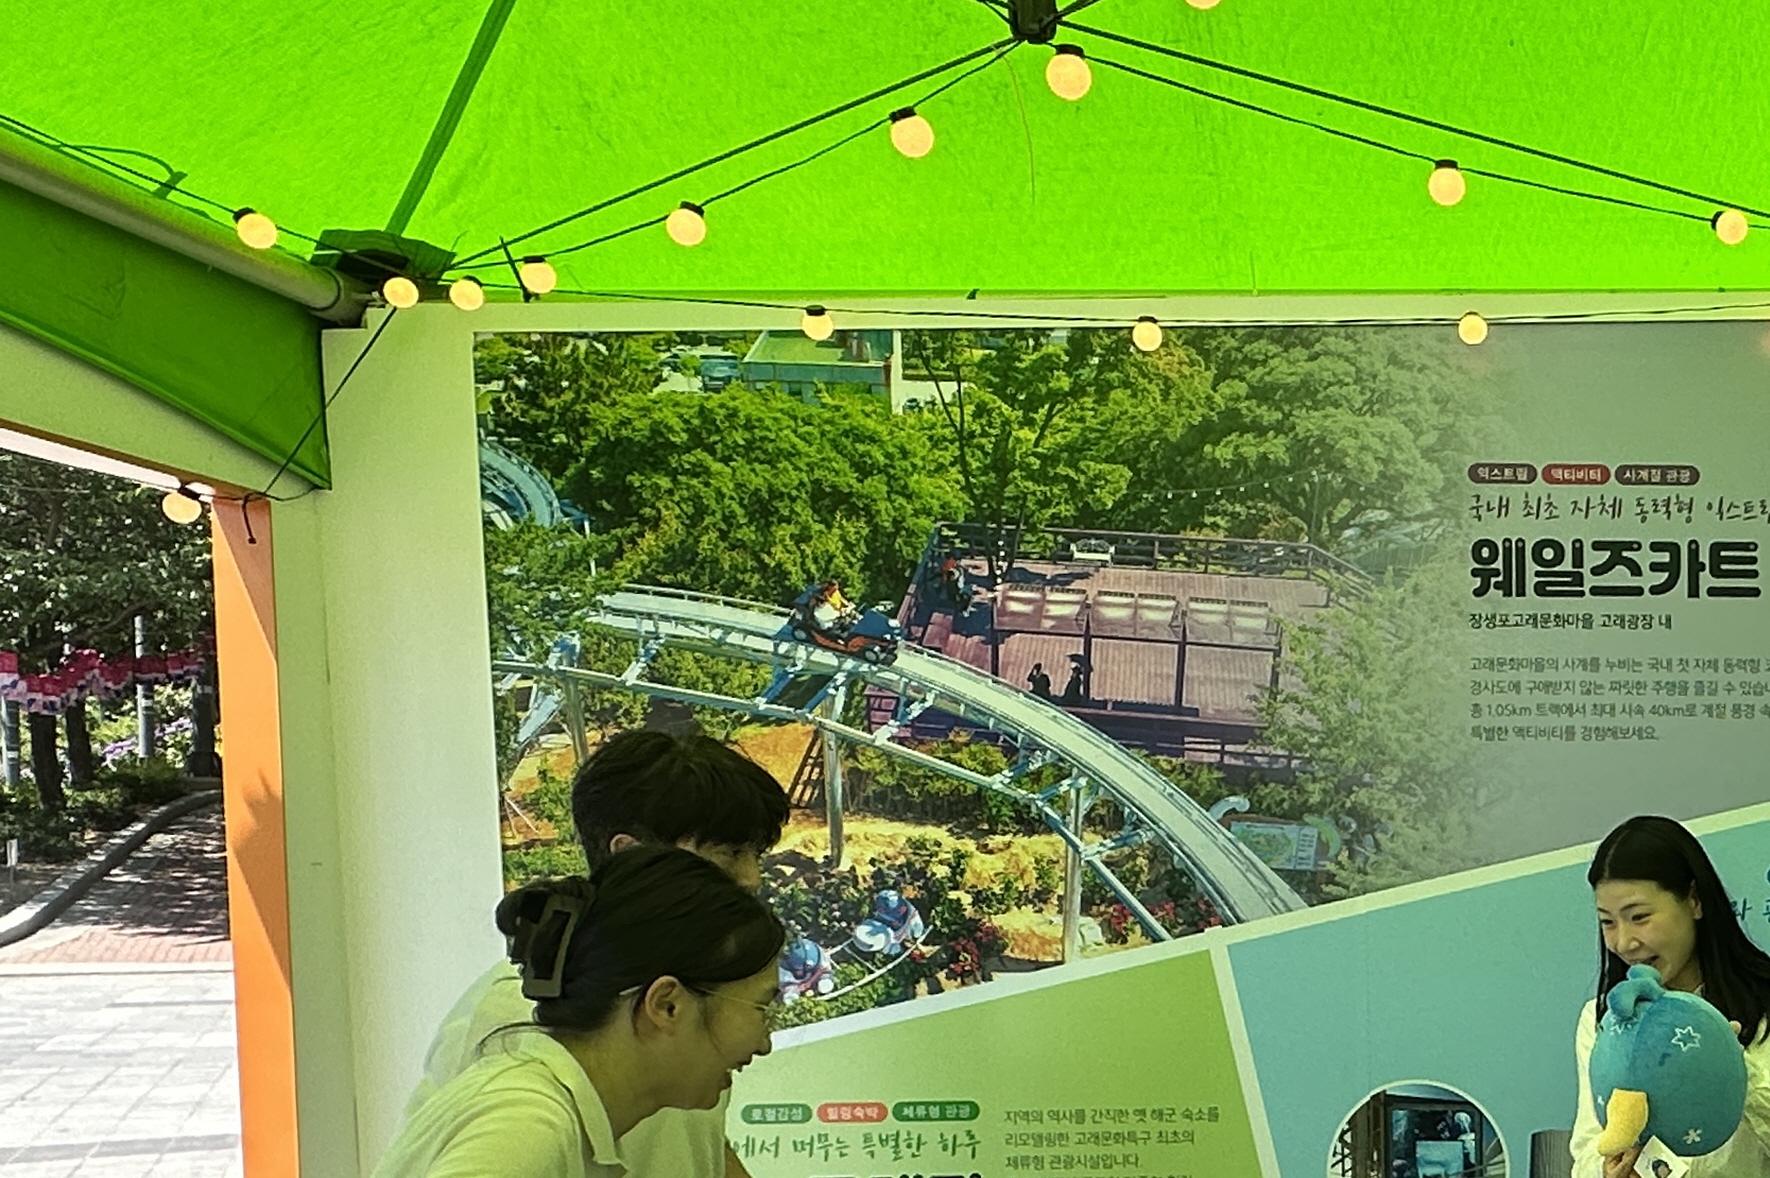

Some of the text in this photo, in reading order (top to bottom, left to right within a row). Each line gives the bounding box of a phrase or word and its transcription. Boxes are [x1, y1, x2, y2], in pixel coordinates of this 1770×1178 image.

[1550, 467, 1603, 482] 액티비티
[1468, 494, 1510, 523] 국내
[1522, 492, 1561, 521] 최초
[1570, 494, 1623, 519] 자체
[1634, 495, 1695, 524] 동력형
[1470, 537, 1763, 599] 웨일즈카트
[1468, 613, 1673, 631] 장생포고래문화마을 고래광장 내
[1605, 657, 1643, 673] 누비는
[1647, 657, 1673, 673] 국내
[1722, 681, 1737, 696] 수
[1486, 703, 1533, 718] 1.05km
[1090, 1108, 1130, 1125] 간직한
[792, 1132, 851, 1163] 머무는
[862, 1129, 928, 1162] 특별한
[936, 1129, 983, 1160] 하루
